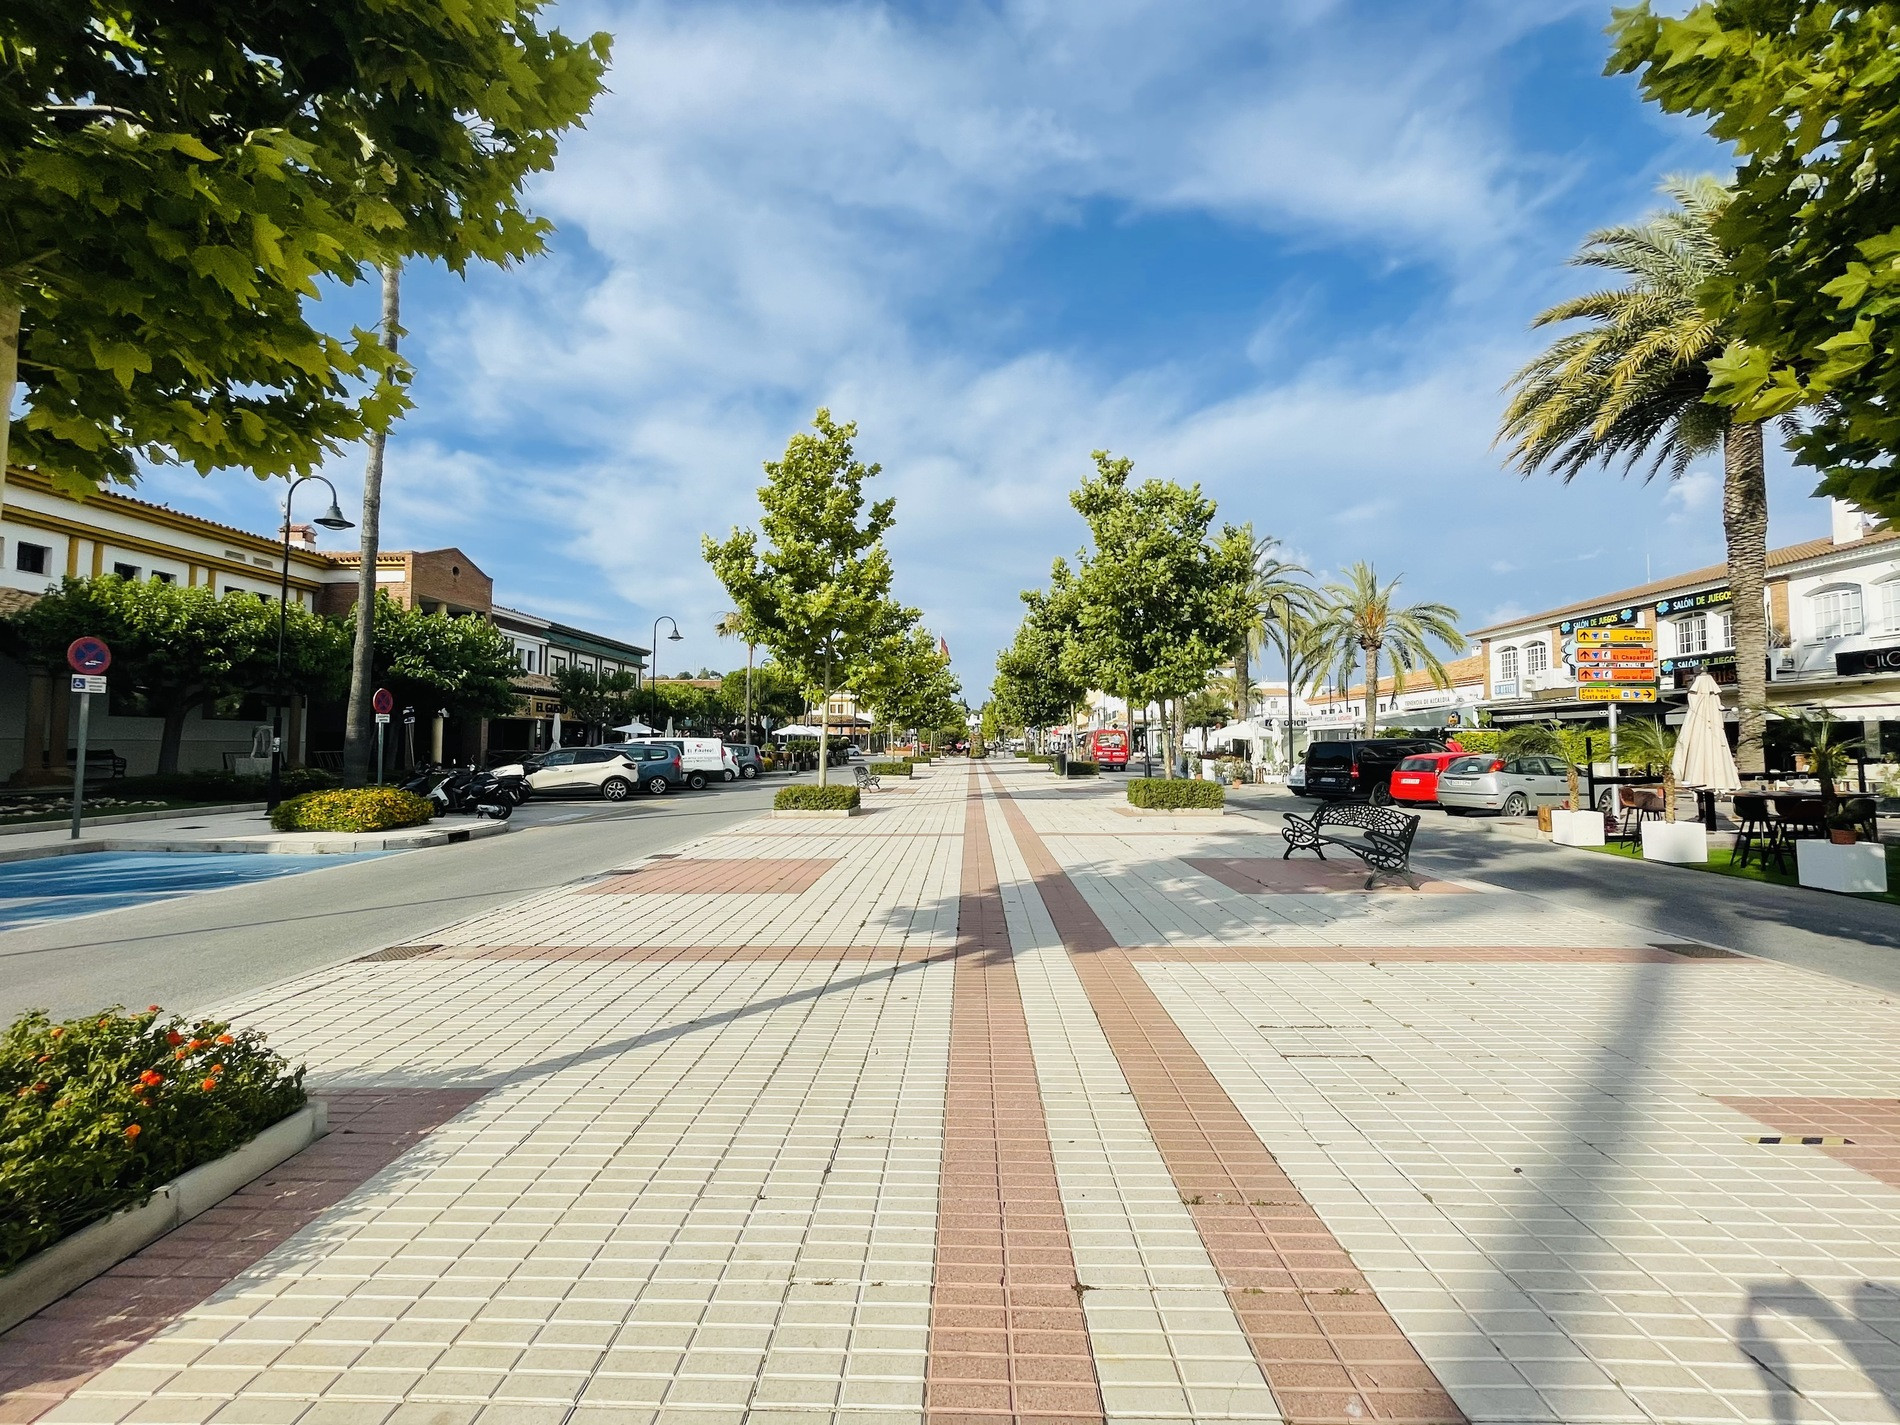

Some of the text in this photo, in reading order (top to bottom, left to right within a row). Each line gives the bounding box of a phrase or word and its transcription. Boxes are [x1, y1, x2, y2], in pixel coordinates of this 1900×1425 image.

[1673, 591, 1732, 610] SALÓN DE JUEGO
[1573, 614, 1618, 629] SALÓN DE JUEGOS
